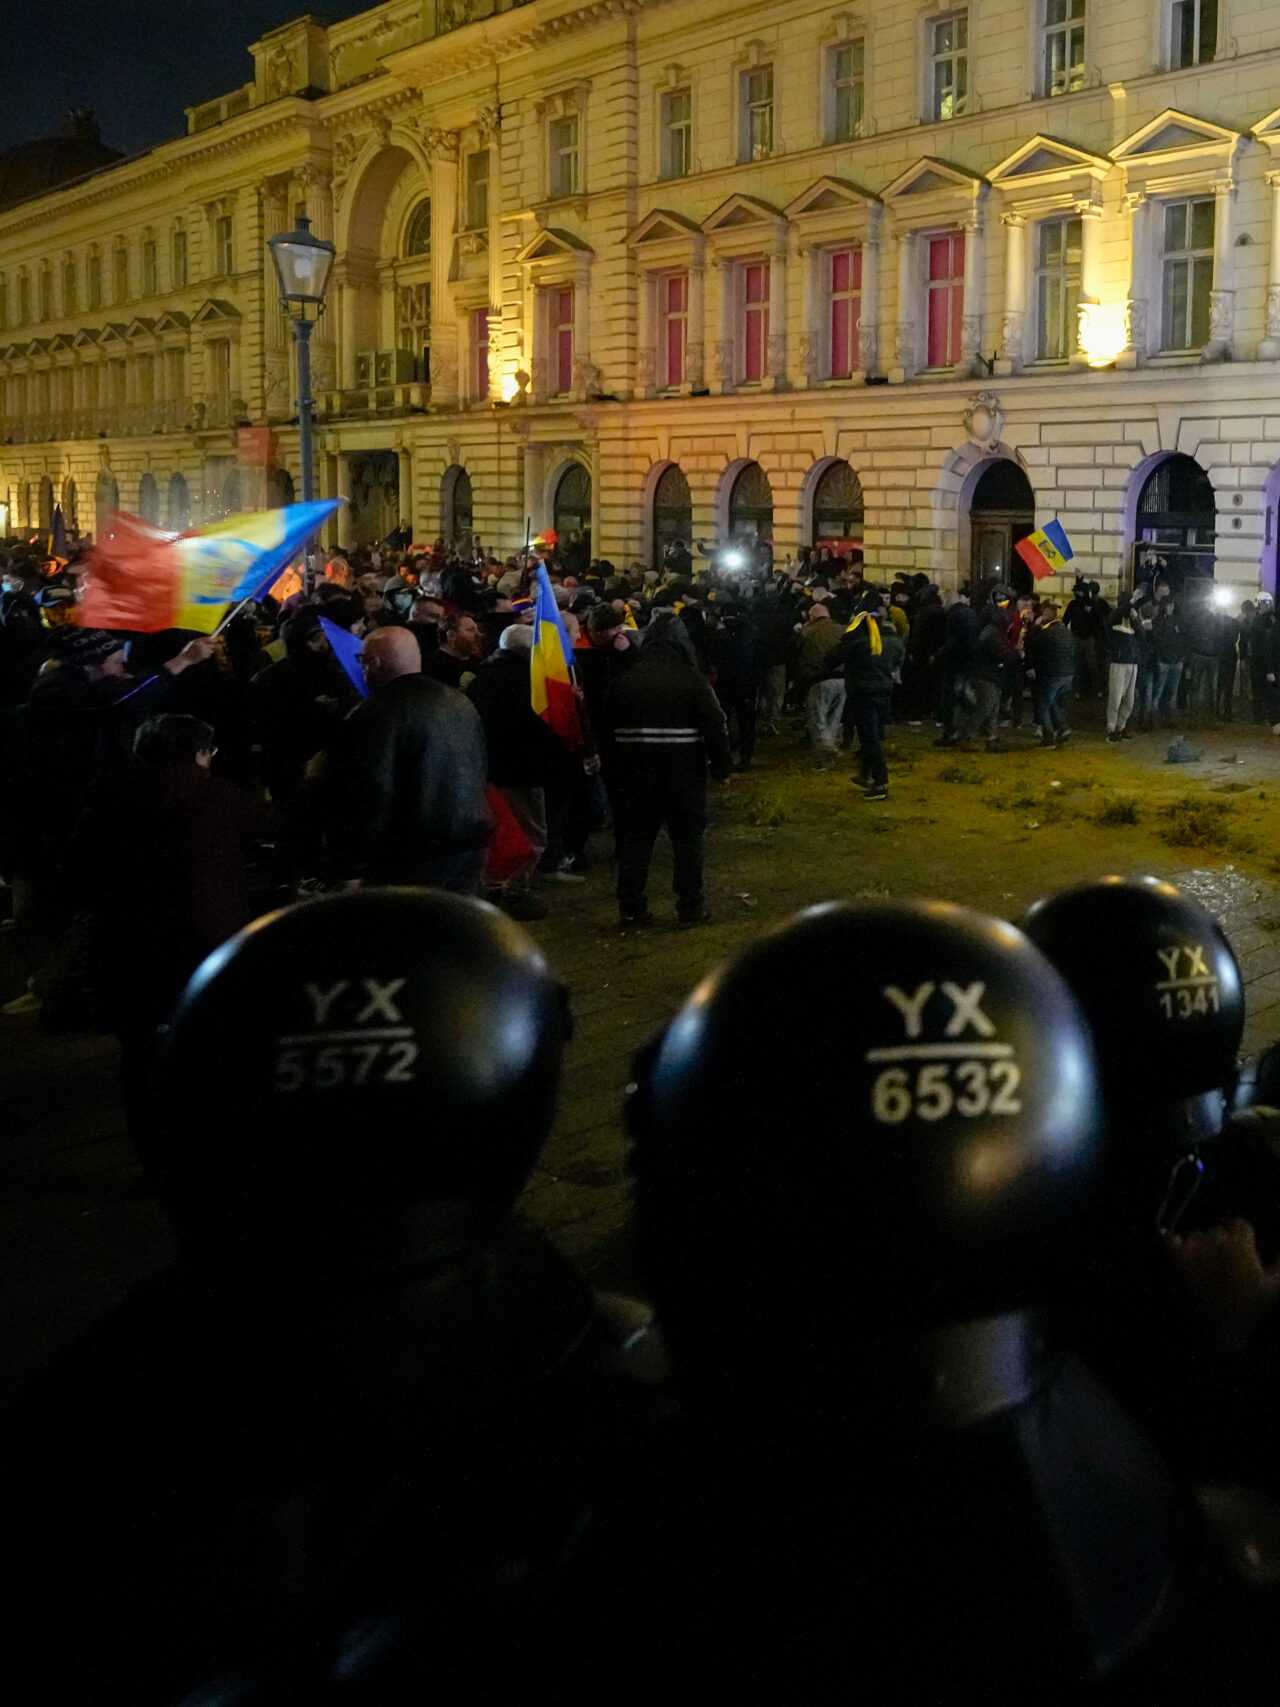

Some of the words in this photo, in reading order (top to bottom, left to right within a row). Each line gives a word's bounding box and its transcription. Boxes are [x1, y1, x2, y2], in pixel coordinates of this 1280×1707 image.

[1156, 946, 1208, 980] YX
[304, 977, 406, 1023] YX
[882, 979, 997, 1038] YX
[1160, 985, 1219, 1019] 1341
[275, 1041, 419, 1092] 5572
[872, 1061, 1023, 1125] 6532
